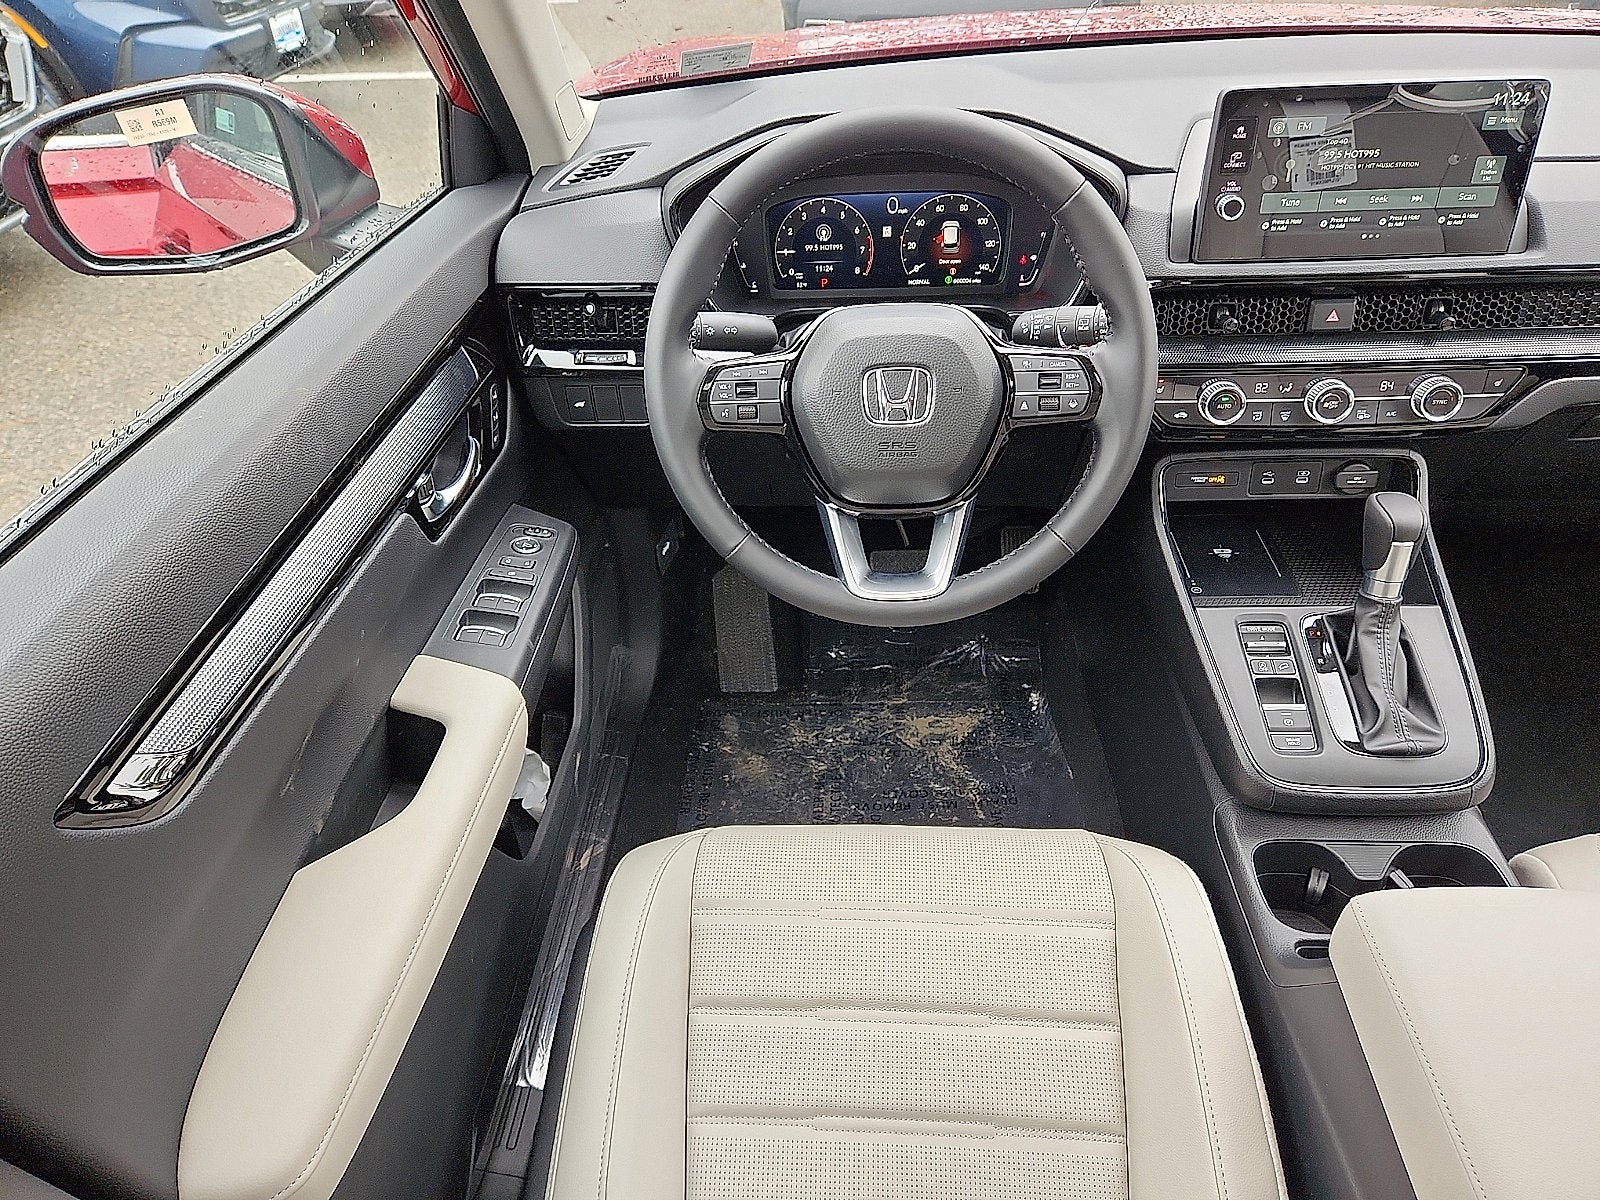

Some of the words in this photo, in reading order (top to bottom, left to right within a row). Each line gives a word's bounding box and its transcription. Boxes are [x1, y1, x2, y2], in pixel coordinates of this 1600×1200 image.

[1493, 92, 1531, 105] 11:24
[1296, 122, 1312, 130] FM
[1327, 138, 1338, 146] Top
[1324, 151, 1342, 159] 99.5
[1344, 149, 1380, 158] HOT995
[1281, 198, 1300, 206] Tune
[1369, 195, 1388, 203] Seek
[886, 196, 899, 214] 0
[960, 204, 968, 212] 80
[821, 206, 826, 214] 4
[802, 212, 807, 220] 3
[840, 211, 845, 219] 5
[788, 227, 793, 235] 2
[854, 226, 860, 234] 6
[907, 242, 916, 250] 20
[860, 246, 865, 255] 7
[821, 278, 828, 287] P
[1255, 383, 1268, 393] 82
[879, 441, 917, 449] SRS
